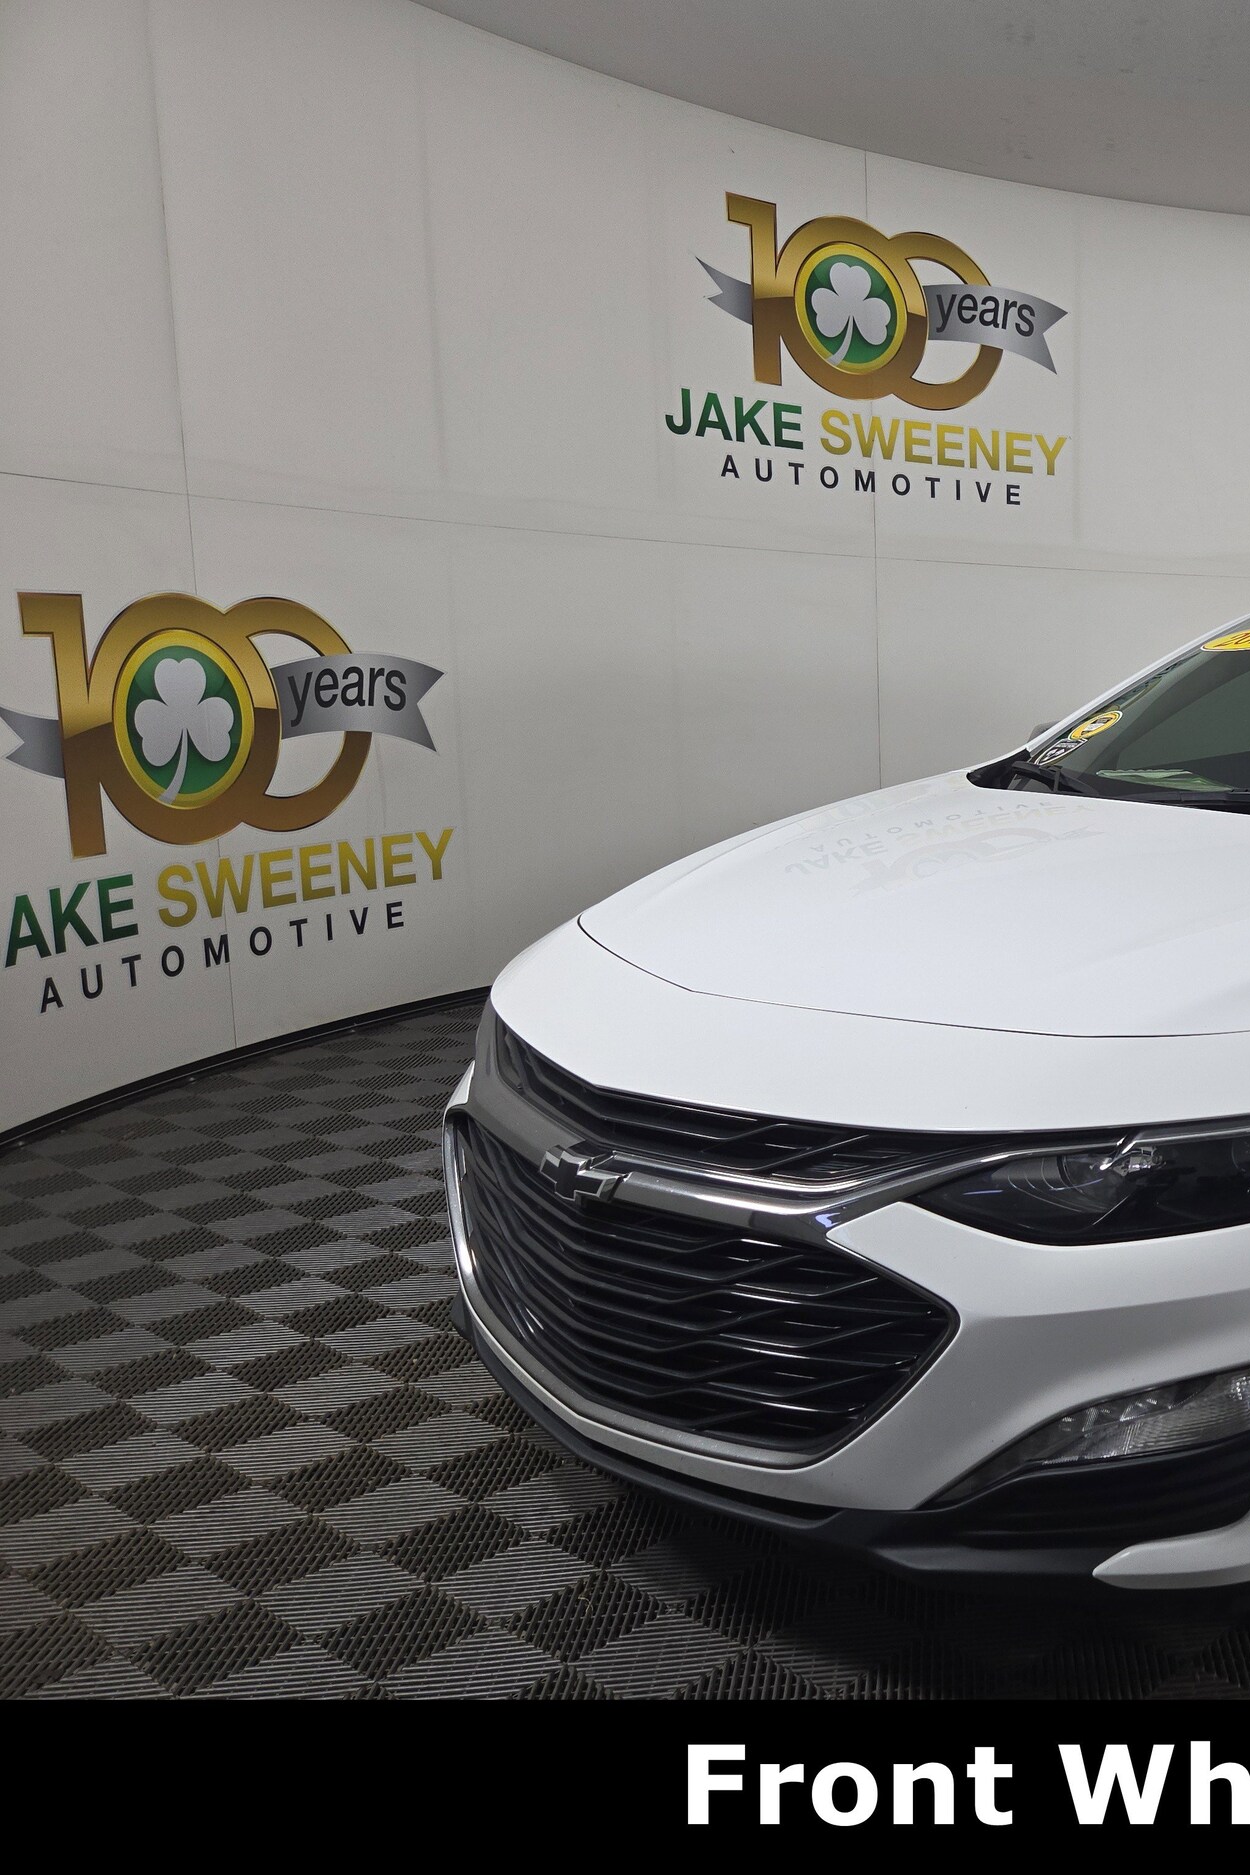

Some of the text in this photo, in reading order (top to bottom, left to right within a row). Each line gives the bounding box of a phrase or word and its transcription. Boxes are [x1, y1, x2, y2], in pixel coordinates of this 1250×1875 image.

[936, 294, 1036, 337] years
[665, 388, 1067, 476] JAKE SWEENEY
[721, 455, 1021, 505] AUTOMOTIVE
[287, 665, 407, 726] years
[157, 828, 454, 928] SWEENEY
[40, 902, 404, 1014] AUTOMOTIVE
